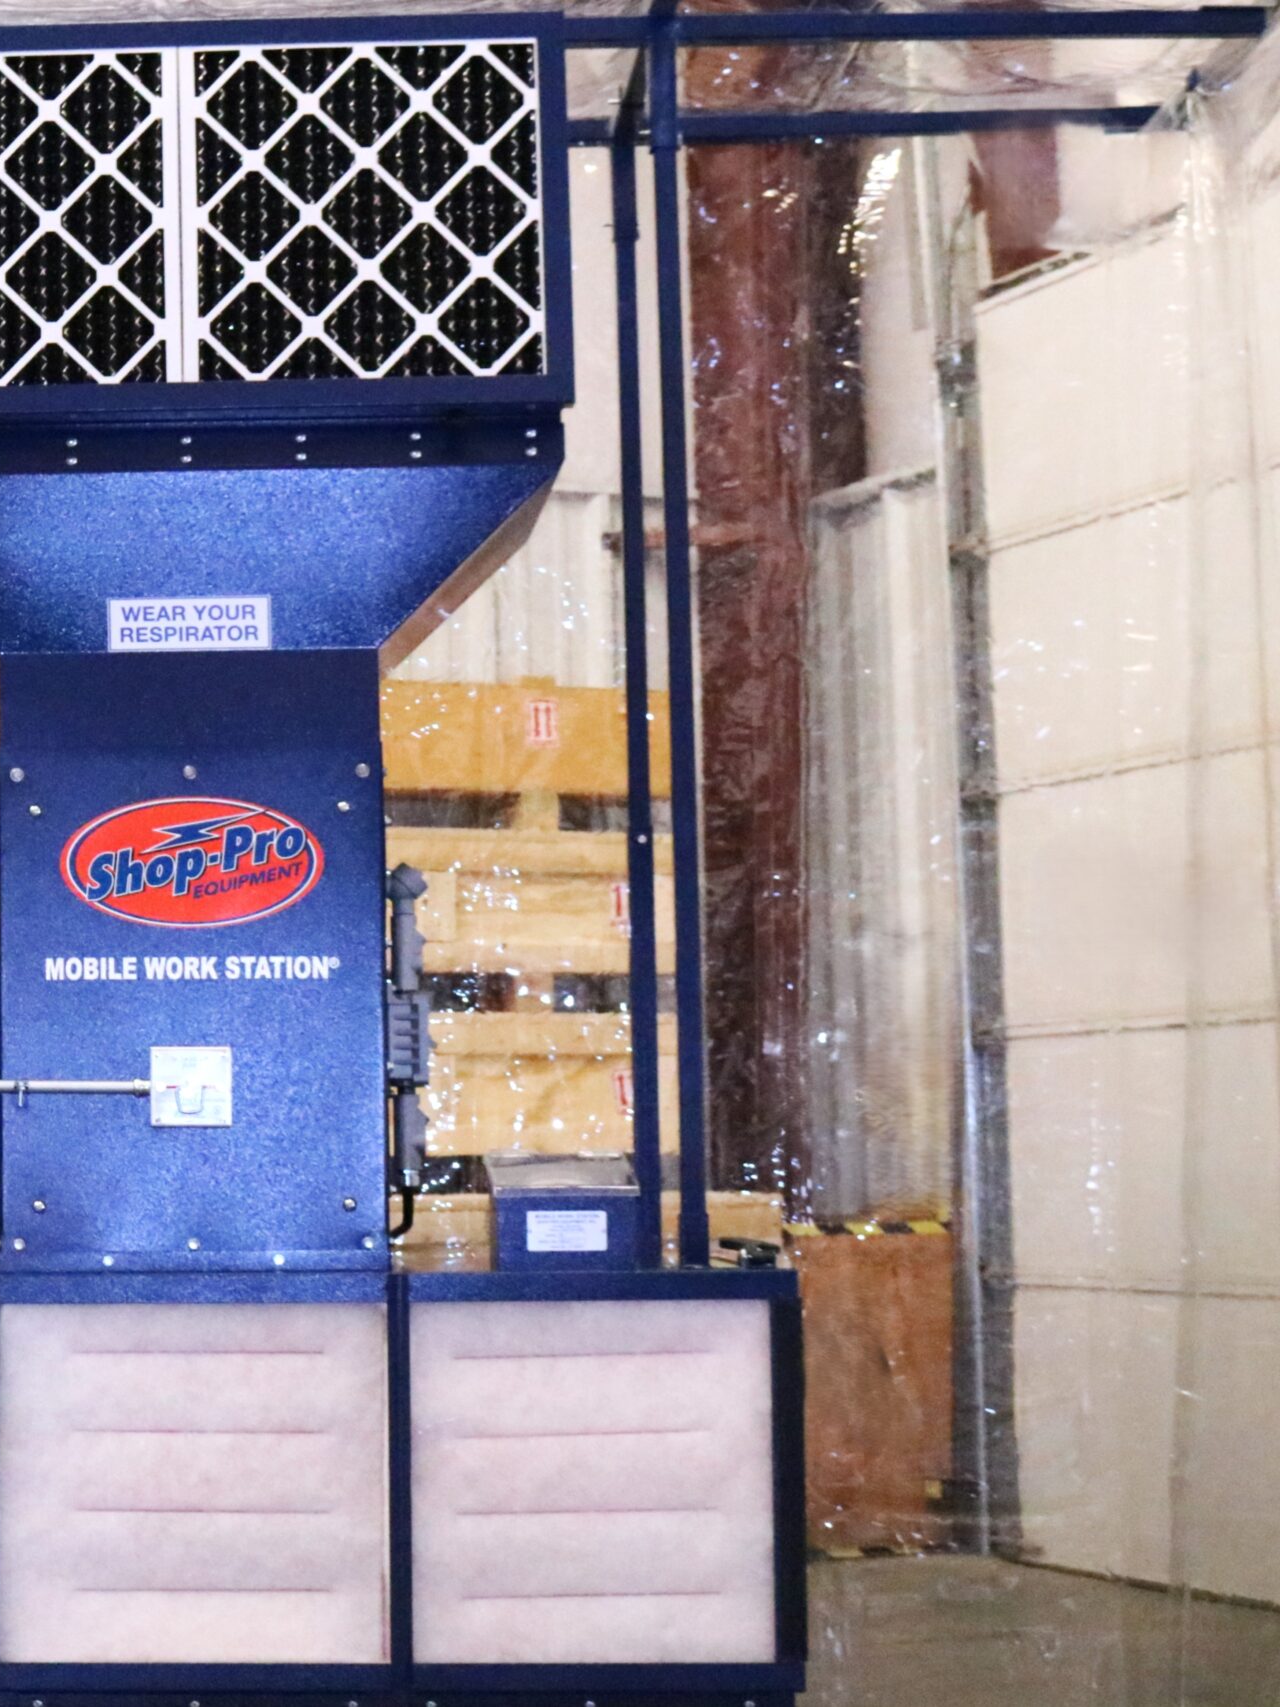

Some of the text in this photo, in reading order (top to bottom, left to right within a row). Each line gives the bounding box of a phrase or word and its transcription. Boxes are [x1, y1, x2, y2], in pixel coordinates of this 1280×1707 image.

[121, 604, 256, 622] WEAR YOUR
[120, 625, 259, 643] RESPIRATOR
[86, 825, 307, 902] Shop-Pro
[193, 861, 303, 900] EQUIPMENT
[45, 957, 137, 980] MOBILE
[144, 956, 218, 980] WORK
